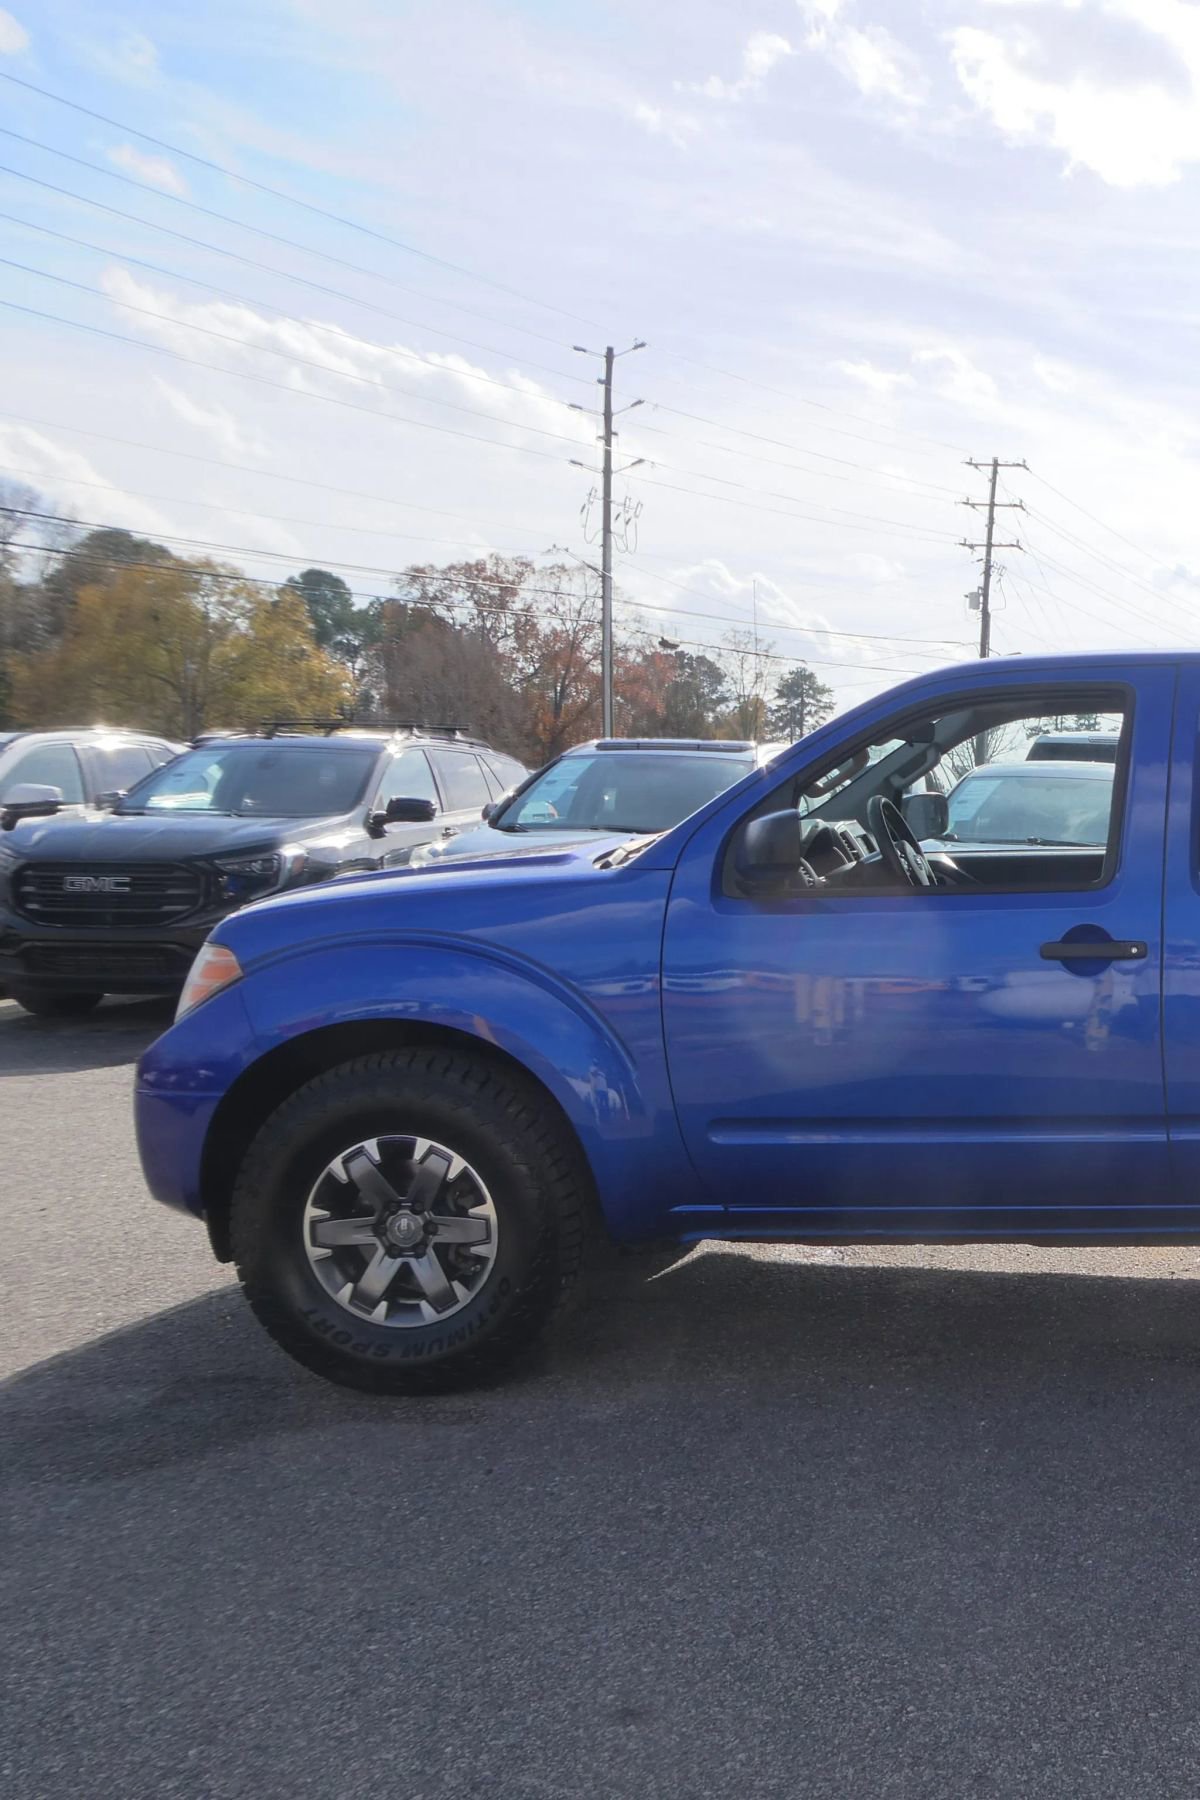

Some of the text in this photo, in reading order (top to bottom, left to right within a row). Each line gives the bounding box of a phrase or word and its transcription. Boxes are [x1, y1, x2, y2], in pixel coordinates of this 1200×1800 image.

[64, 877, 131, 892] GMC
[301, 1277, 511, 1358] OPTIMUM SPORT
